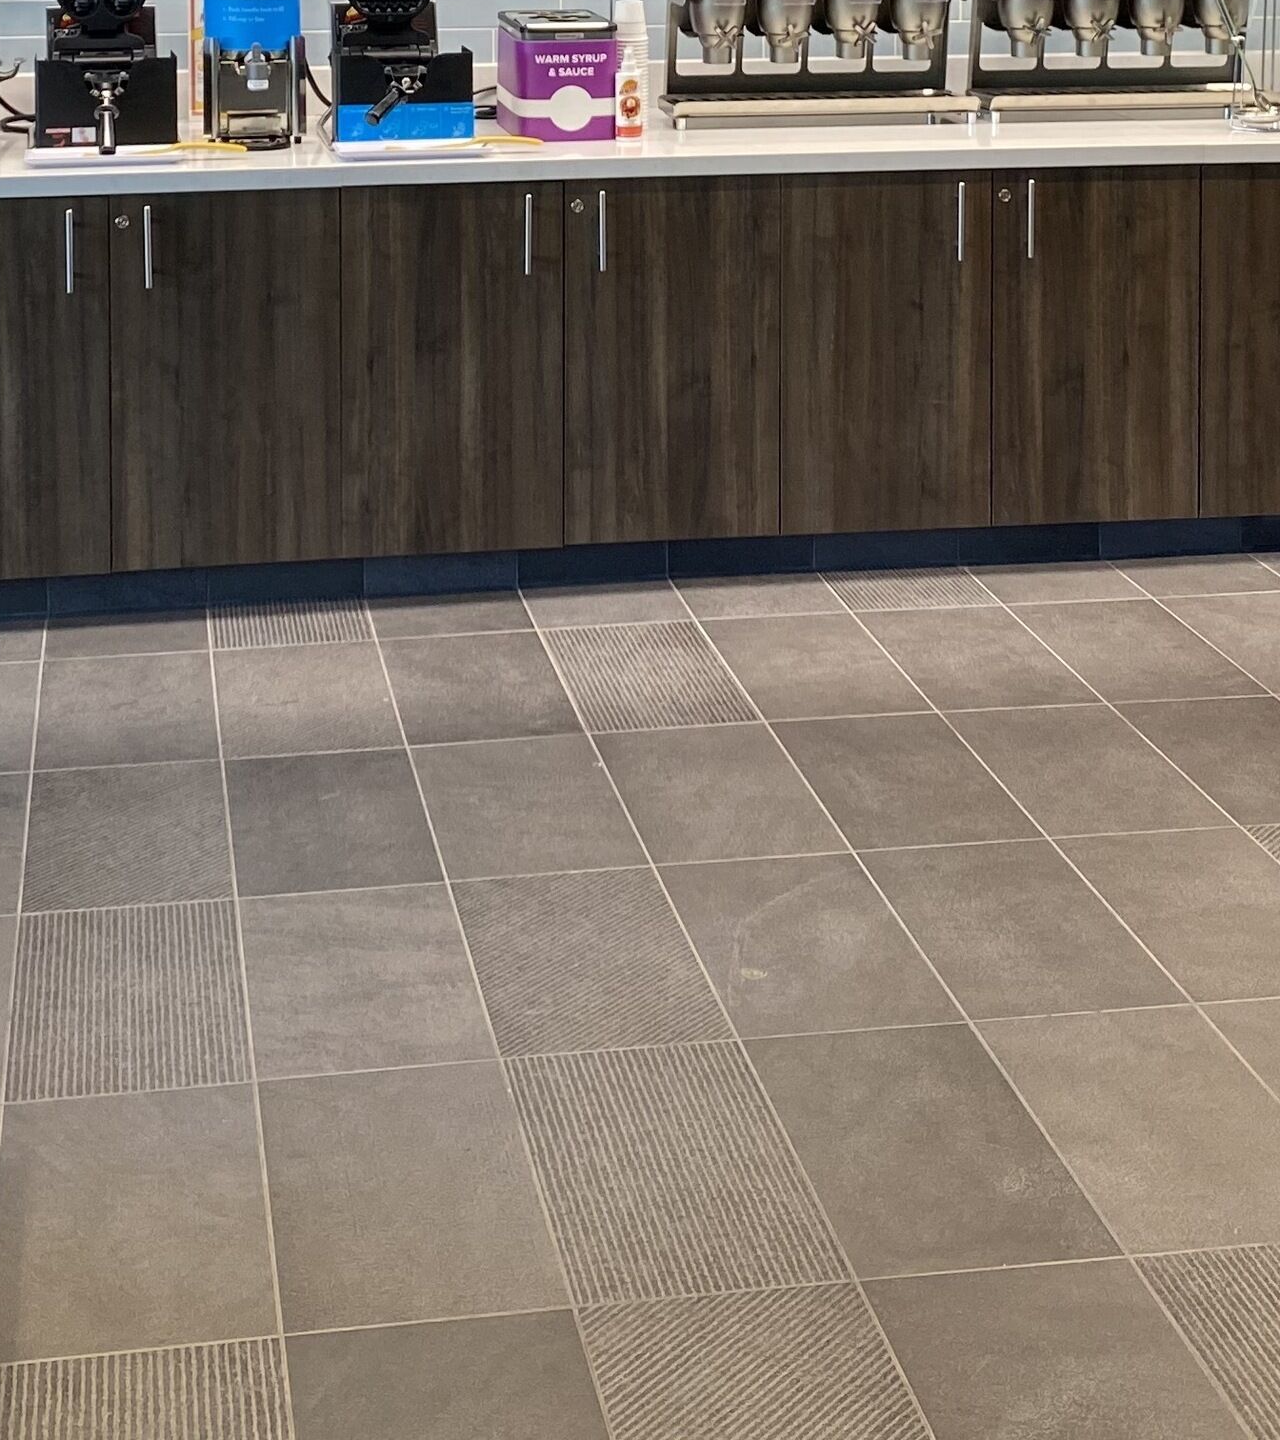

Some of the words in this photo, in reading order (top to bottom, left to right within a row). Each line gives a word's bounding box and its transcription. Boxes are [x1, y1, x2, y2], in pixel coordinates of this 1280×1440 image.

[535, 54, 570, 64] WARM
[571, 53, 607, 64] SYRUP
[548, 67, 556, 77] &
[558, 67, 595, 76] SAUCE
